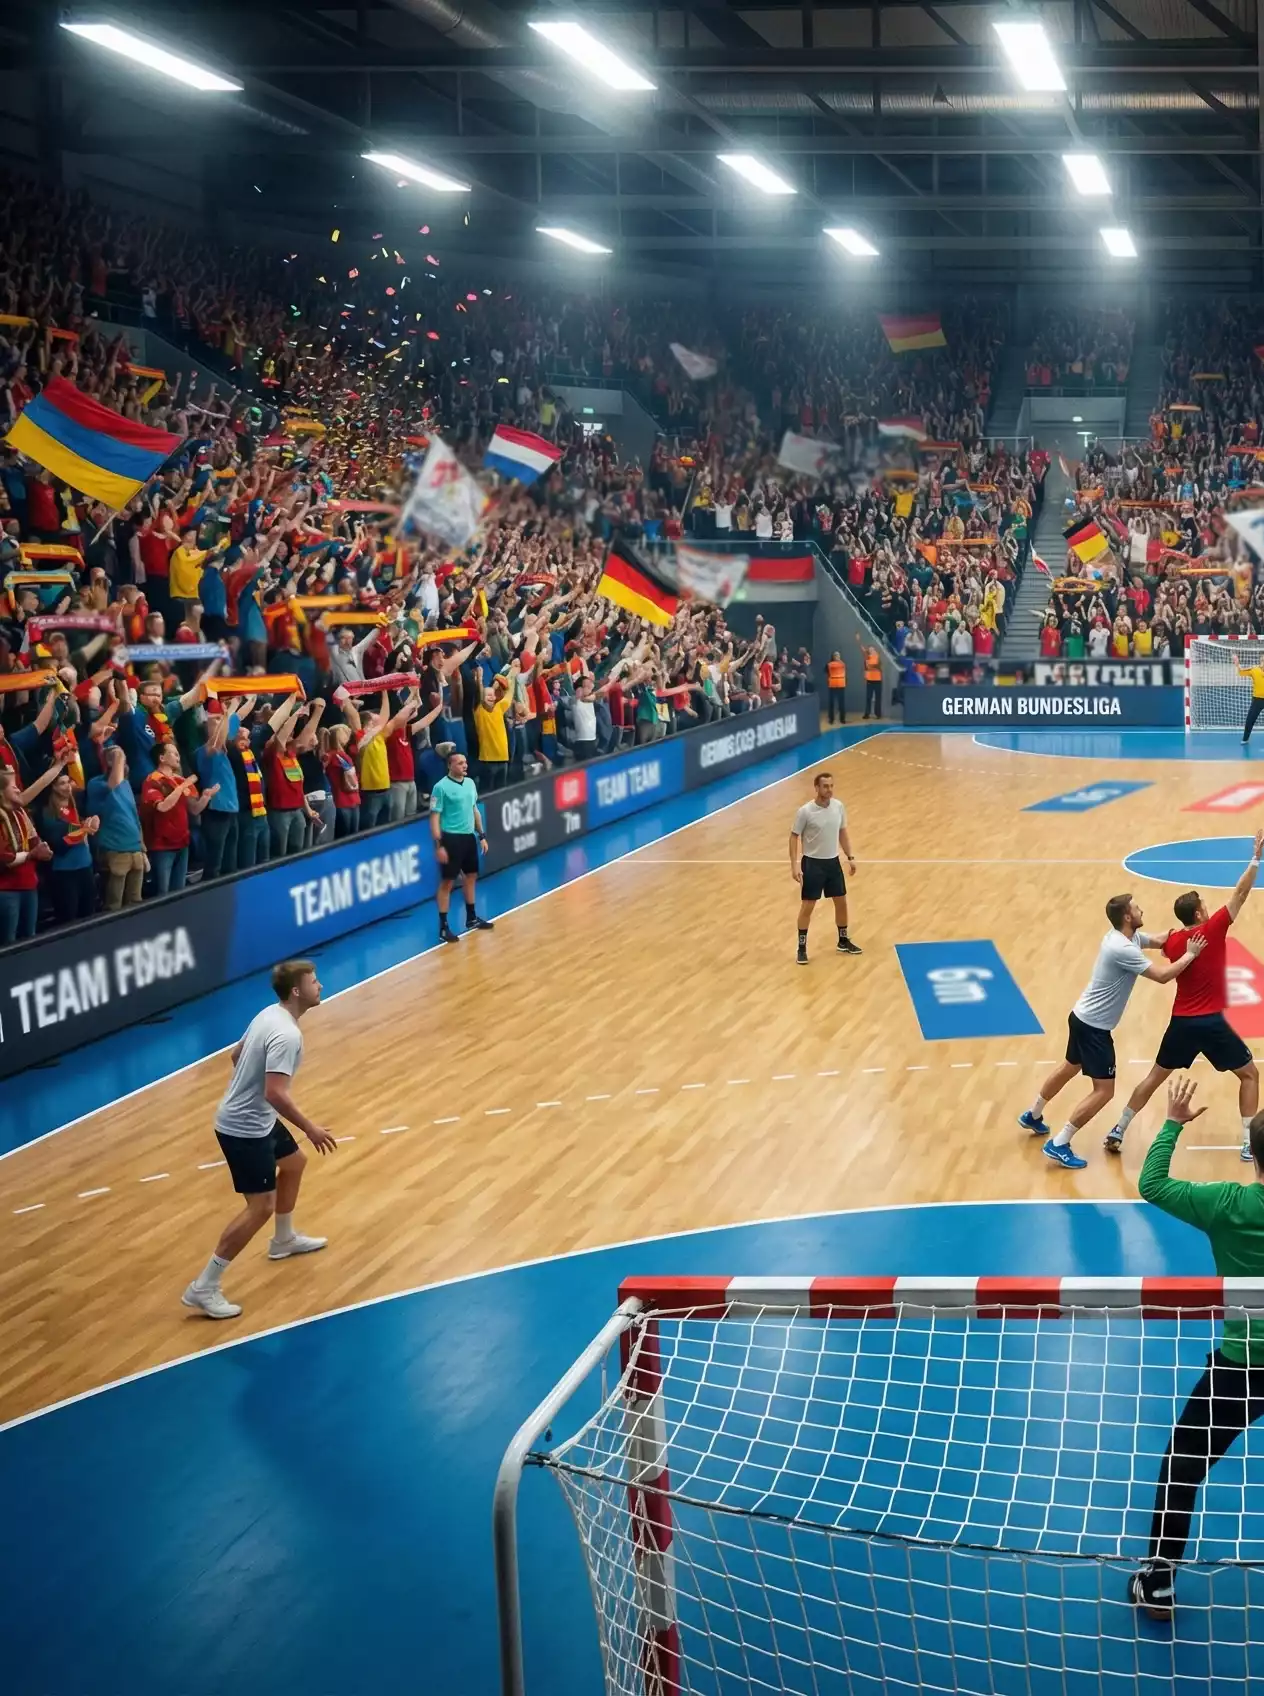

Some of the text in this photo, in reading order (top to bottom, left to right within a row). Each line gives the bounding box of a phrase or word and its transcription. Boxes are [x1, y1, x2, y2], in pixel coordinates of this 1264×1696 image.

[942, 697, 1122, 716] GERMAN BUNDESLIGA
[289, 868, 353, 927] TEAM
[10, 954, 110, 1034] TEAM
